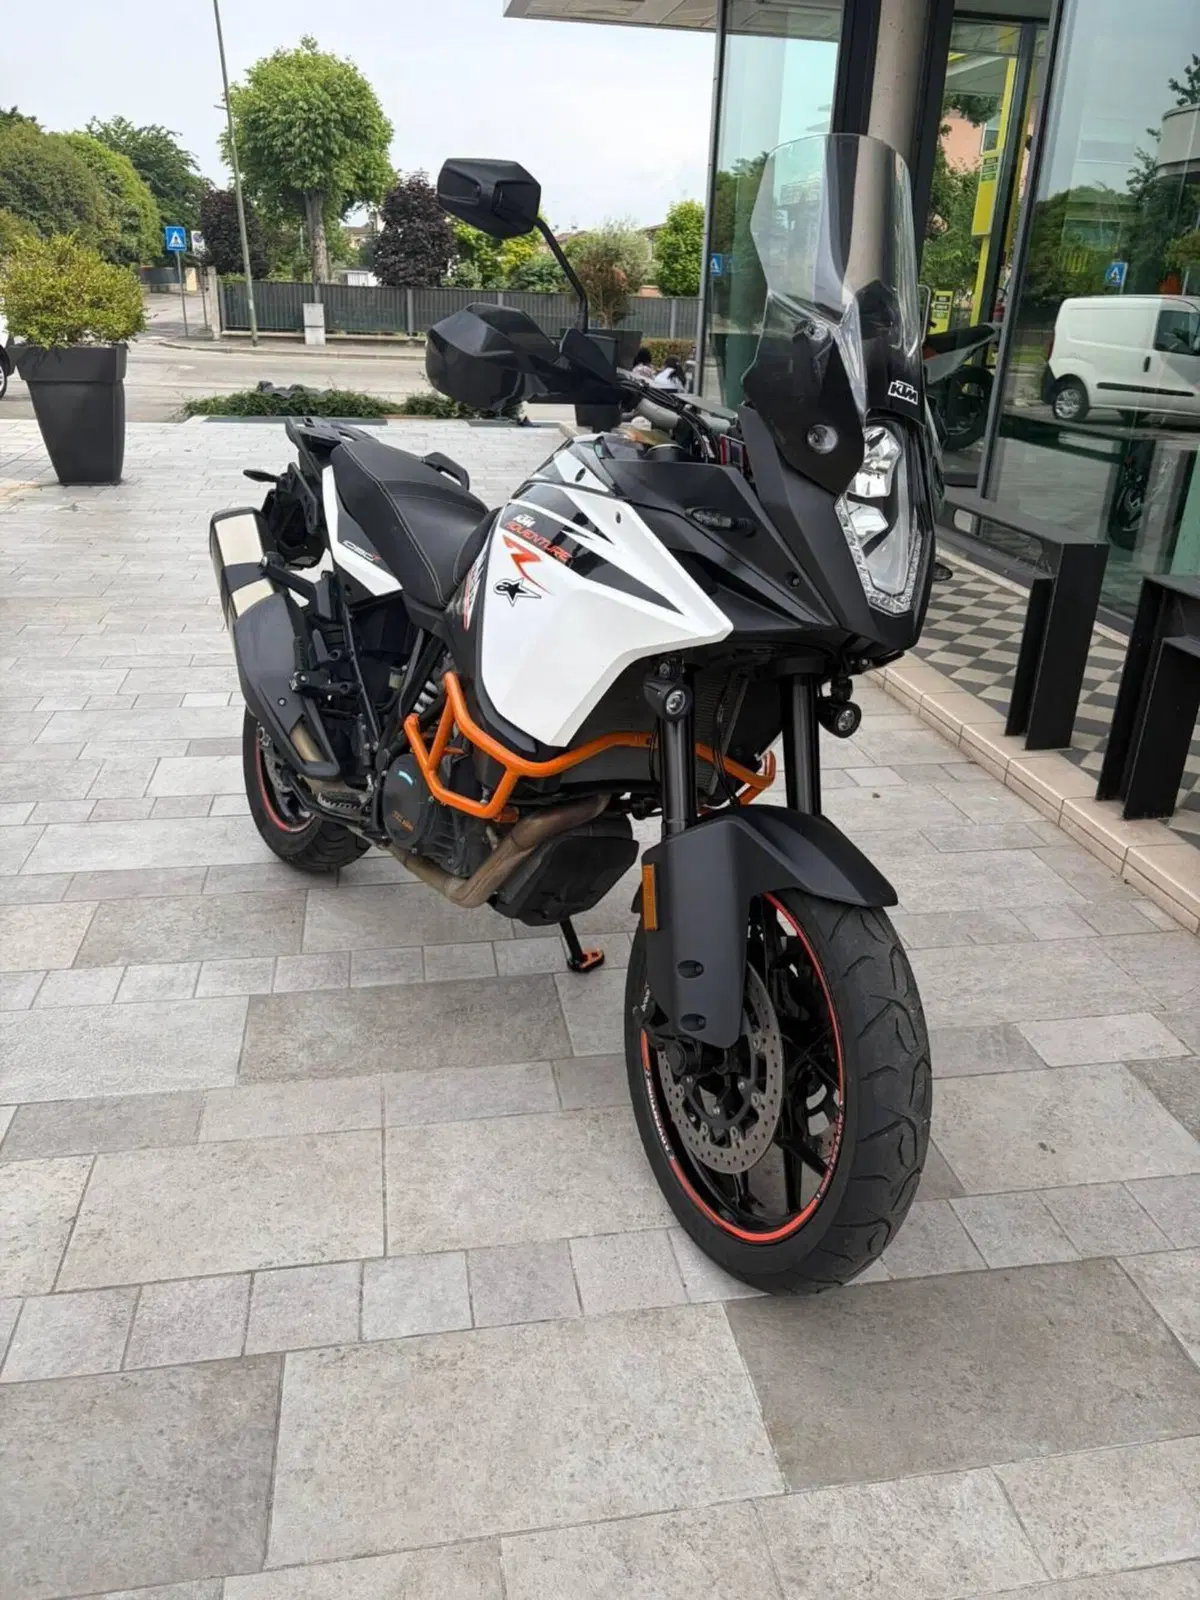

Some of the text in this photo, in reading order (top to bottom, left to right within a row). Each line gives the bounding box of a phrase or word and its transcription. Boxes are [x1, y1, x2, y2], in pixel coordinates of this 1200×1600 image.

[888, 380, 918, 405] KTM
[512, 513, 537, 528] KTM
[504, 520, 573, 562] ADVENTURE
